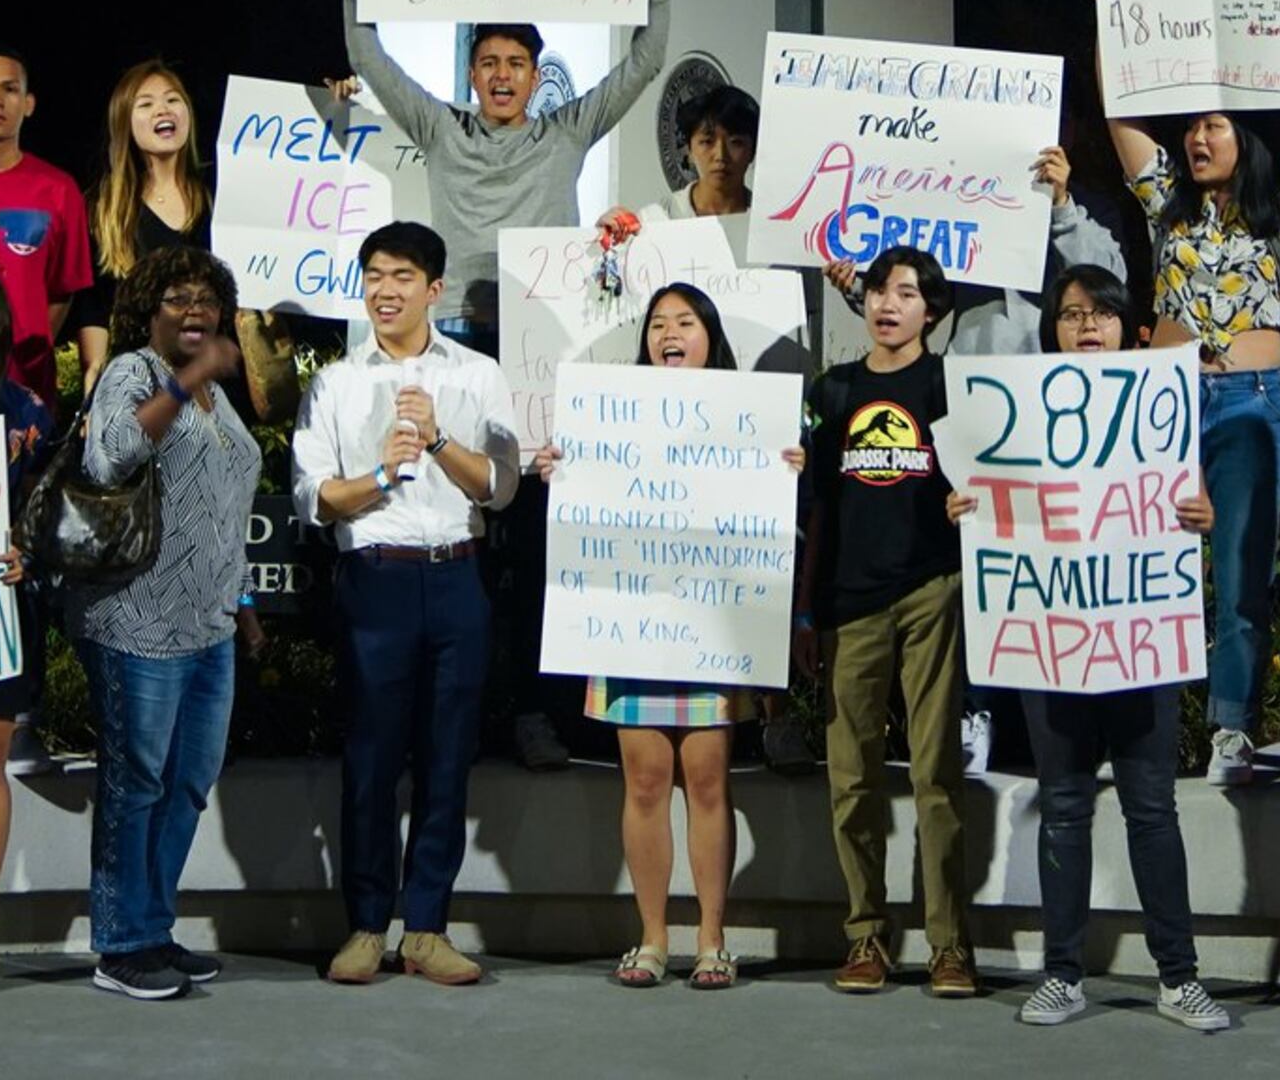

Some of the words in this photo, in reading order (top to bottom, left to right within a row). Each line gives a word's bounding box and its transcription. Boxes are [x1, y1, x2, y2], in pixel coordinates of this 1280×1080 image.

[1158, 12, 1212, 40] hours
[232, 113, 382, 165] MELT
[858, 106, 939, 143] make
[286, 176, 371, 236] ICE
[767, 142, 1018, 233] America
[826, 203, 978, 270] GREAT
[247, 255, 279, 280] IN
[524, 234, 667, 300] 28(g)
[661, 397, 711, 433] US
[738, 412, 757, 436] IS
[965, 363, 1193, 469] 287(g)
[839, 448, 891, 473] JURASSIC
[891, 447, 930, 471] PARK
[626, 477, 689, 502] AND
[967, 469, 1192, 543] TEARS
[714, 512, 778, 540] WITH
[577, 535, 620, 560] THE
[560, 568, 593, 595] OF
[614, 570, 656, 596] THE
[976, 547, 1199, 613] FAMILIES
[695, 653, 754, 673] 2008
[988, 613, 1203, 688] APART
